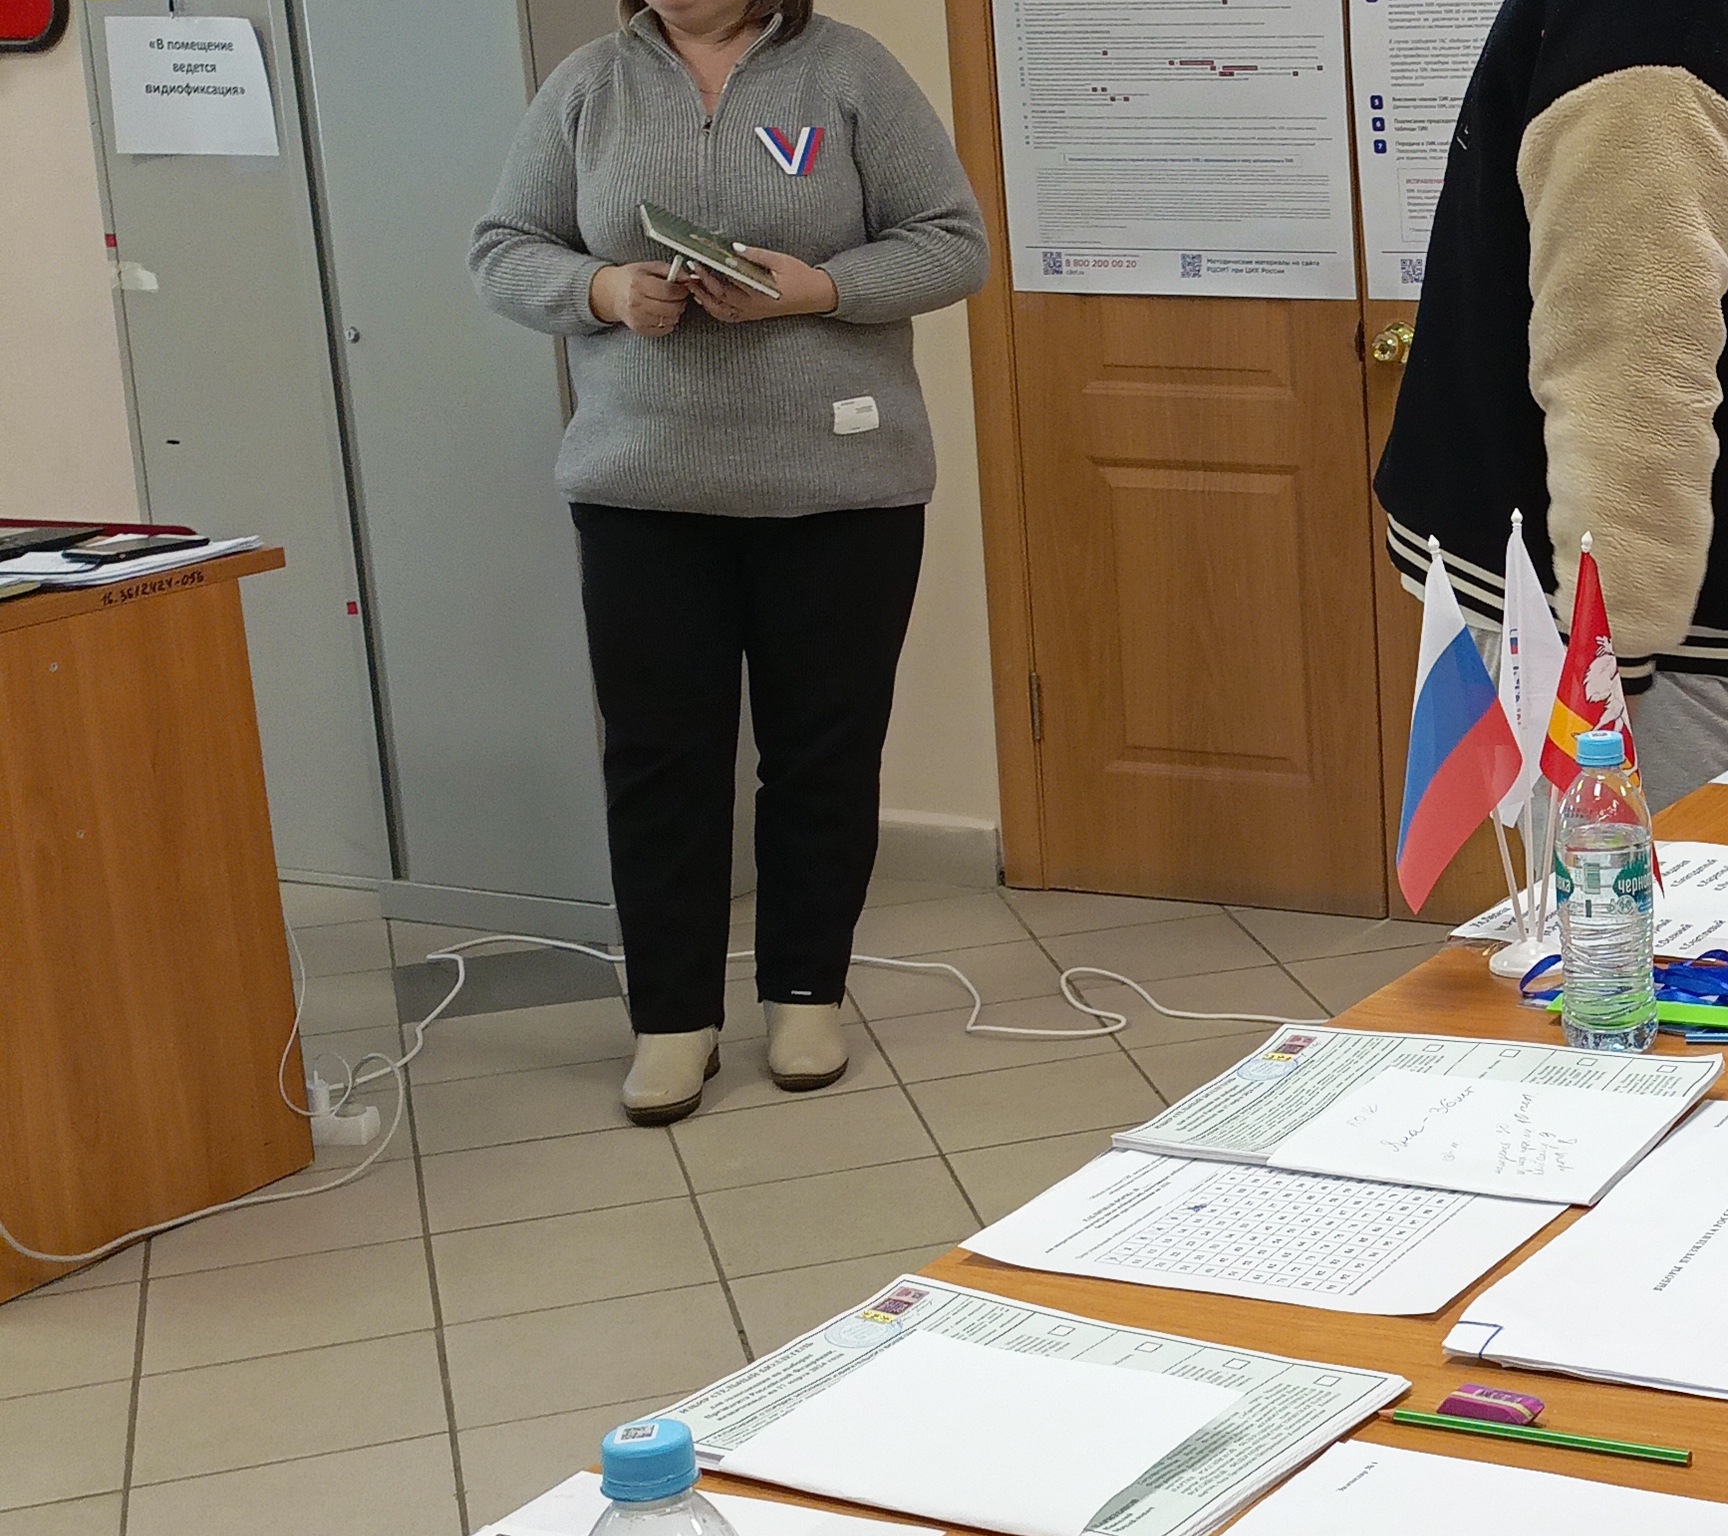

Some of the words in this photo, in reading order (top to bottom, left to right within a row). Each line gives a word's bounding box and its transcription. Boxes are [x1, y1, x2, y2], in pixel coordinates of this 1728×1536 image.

[149, 38, 164, 50] «В
[167, 41, 234, 53] помещение
[172, 63, 217, 75] ведется
[1073, 259, 1089, 268] 800
[1092, 259, 1108, 268] 200
[1126, 260, 1138, 268] 20
[1261, 268, 1285, 276] России
